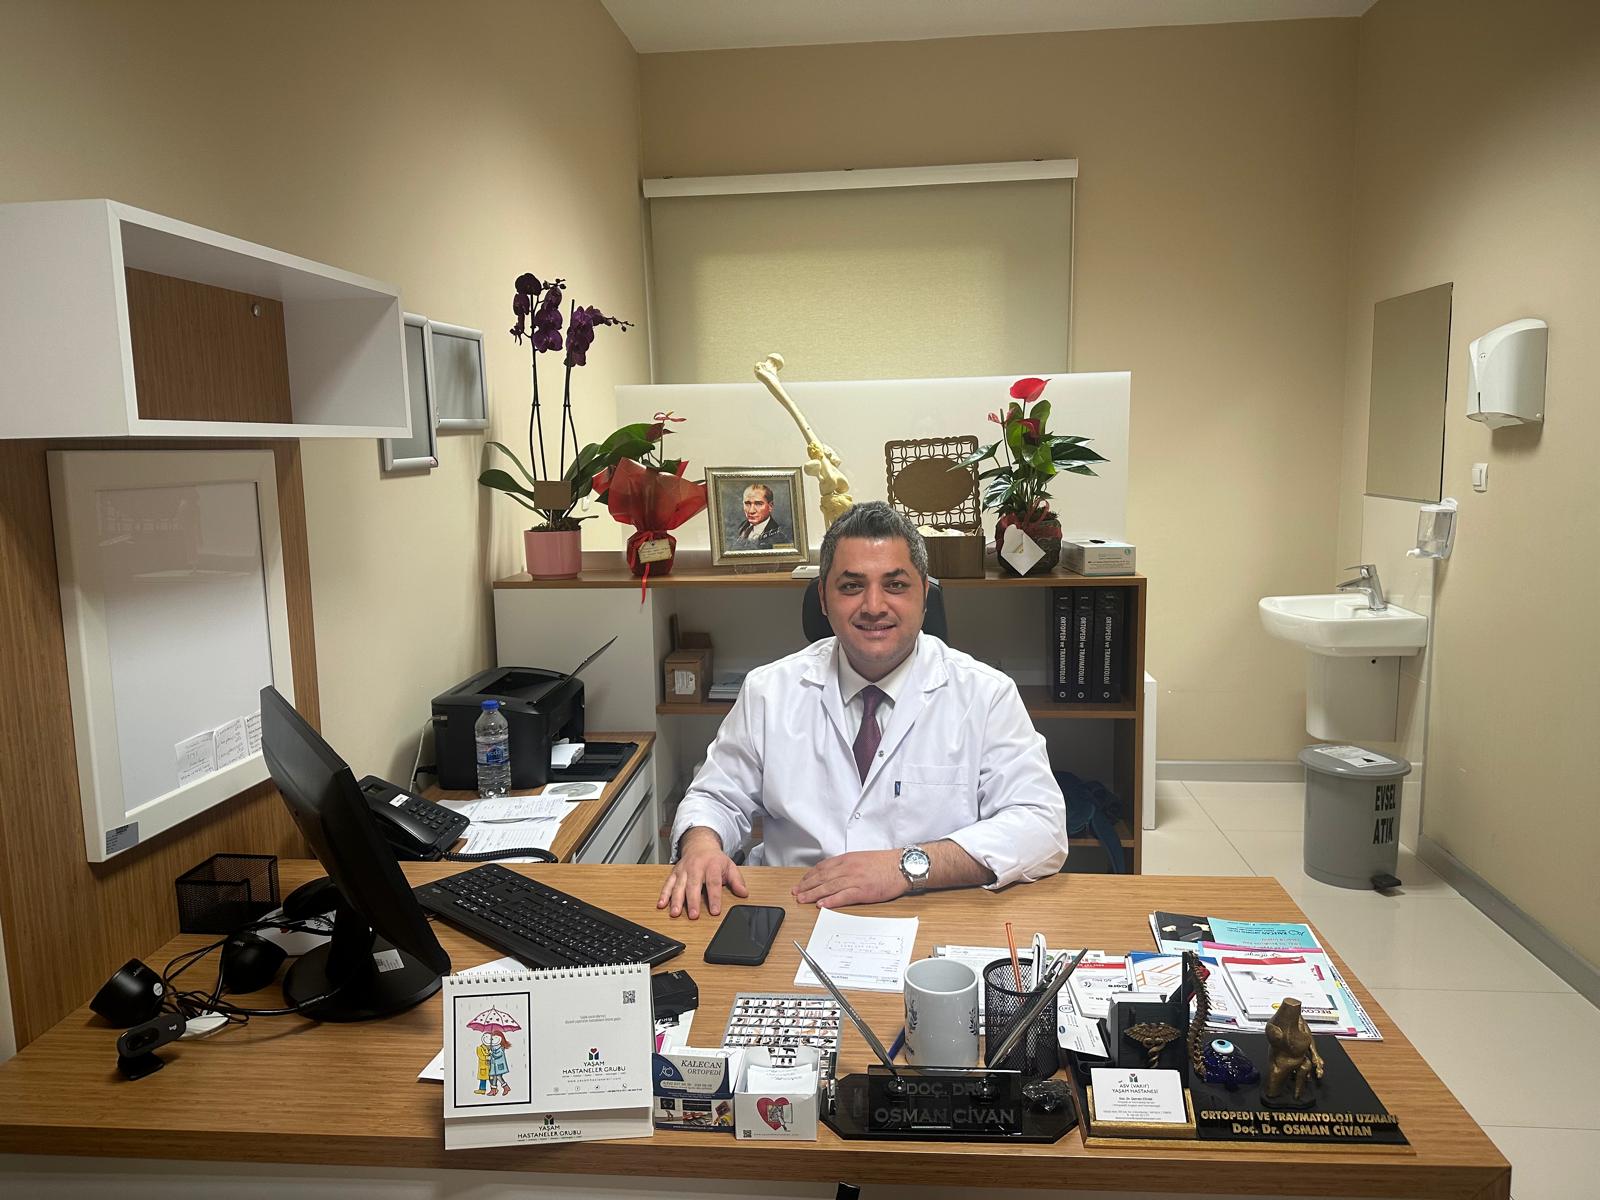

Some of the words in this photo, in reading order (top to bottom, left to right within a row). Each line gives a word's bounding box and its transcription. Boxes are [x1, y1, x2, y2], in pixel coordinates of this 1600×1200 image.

[1375, 784, 1396, 812] EVSEL
[1373, 817, 1394, 844] ATIK
[681, 1060, 722, 1068] KALECAN
[906, 1083, 948, 1098] DOÇ.
[874, 1108, 947, 1123] OSMAN
[952, 1105, 1014, 1124] CİVAN
[1256, 1112, 1270, 1121] VE
[1232, 1122, 1258, 1136] Doç.
[1262, 1124, 1280, 1135] Dr.
[1284, 1124, 1330, 1136] OSMAN
[1333, 1122, 1372, 1136] CİVAN
